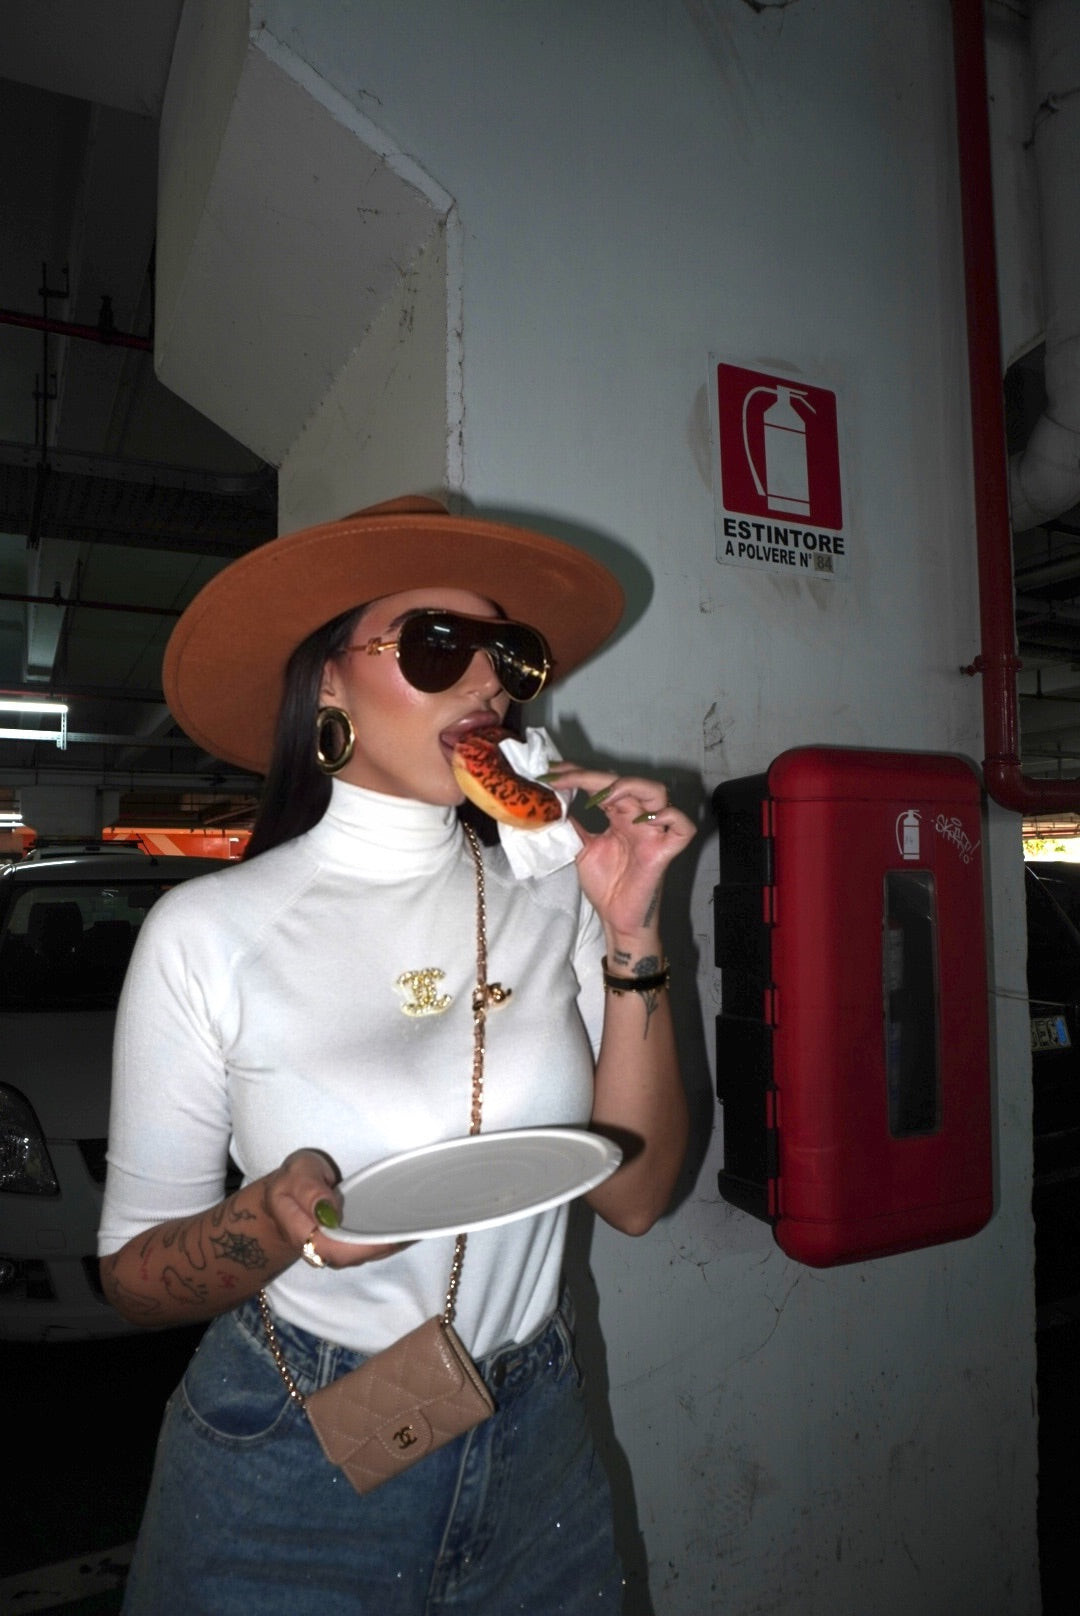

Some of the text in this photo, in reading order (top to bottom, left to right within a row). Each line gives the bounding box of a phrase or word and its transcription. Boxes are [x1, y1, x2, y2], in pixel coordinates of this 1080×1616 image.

[724, 518, 845, 555] ESTINTORE
[725, 541, 735, 556] A
[738, 542, 796, 566] POLVERE
